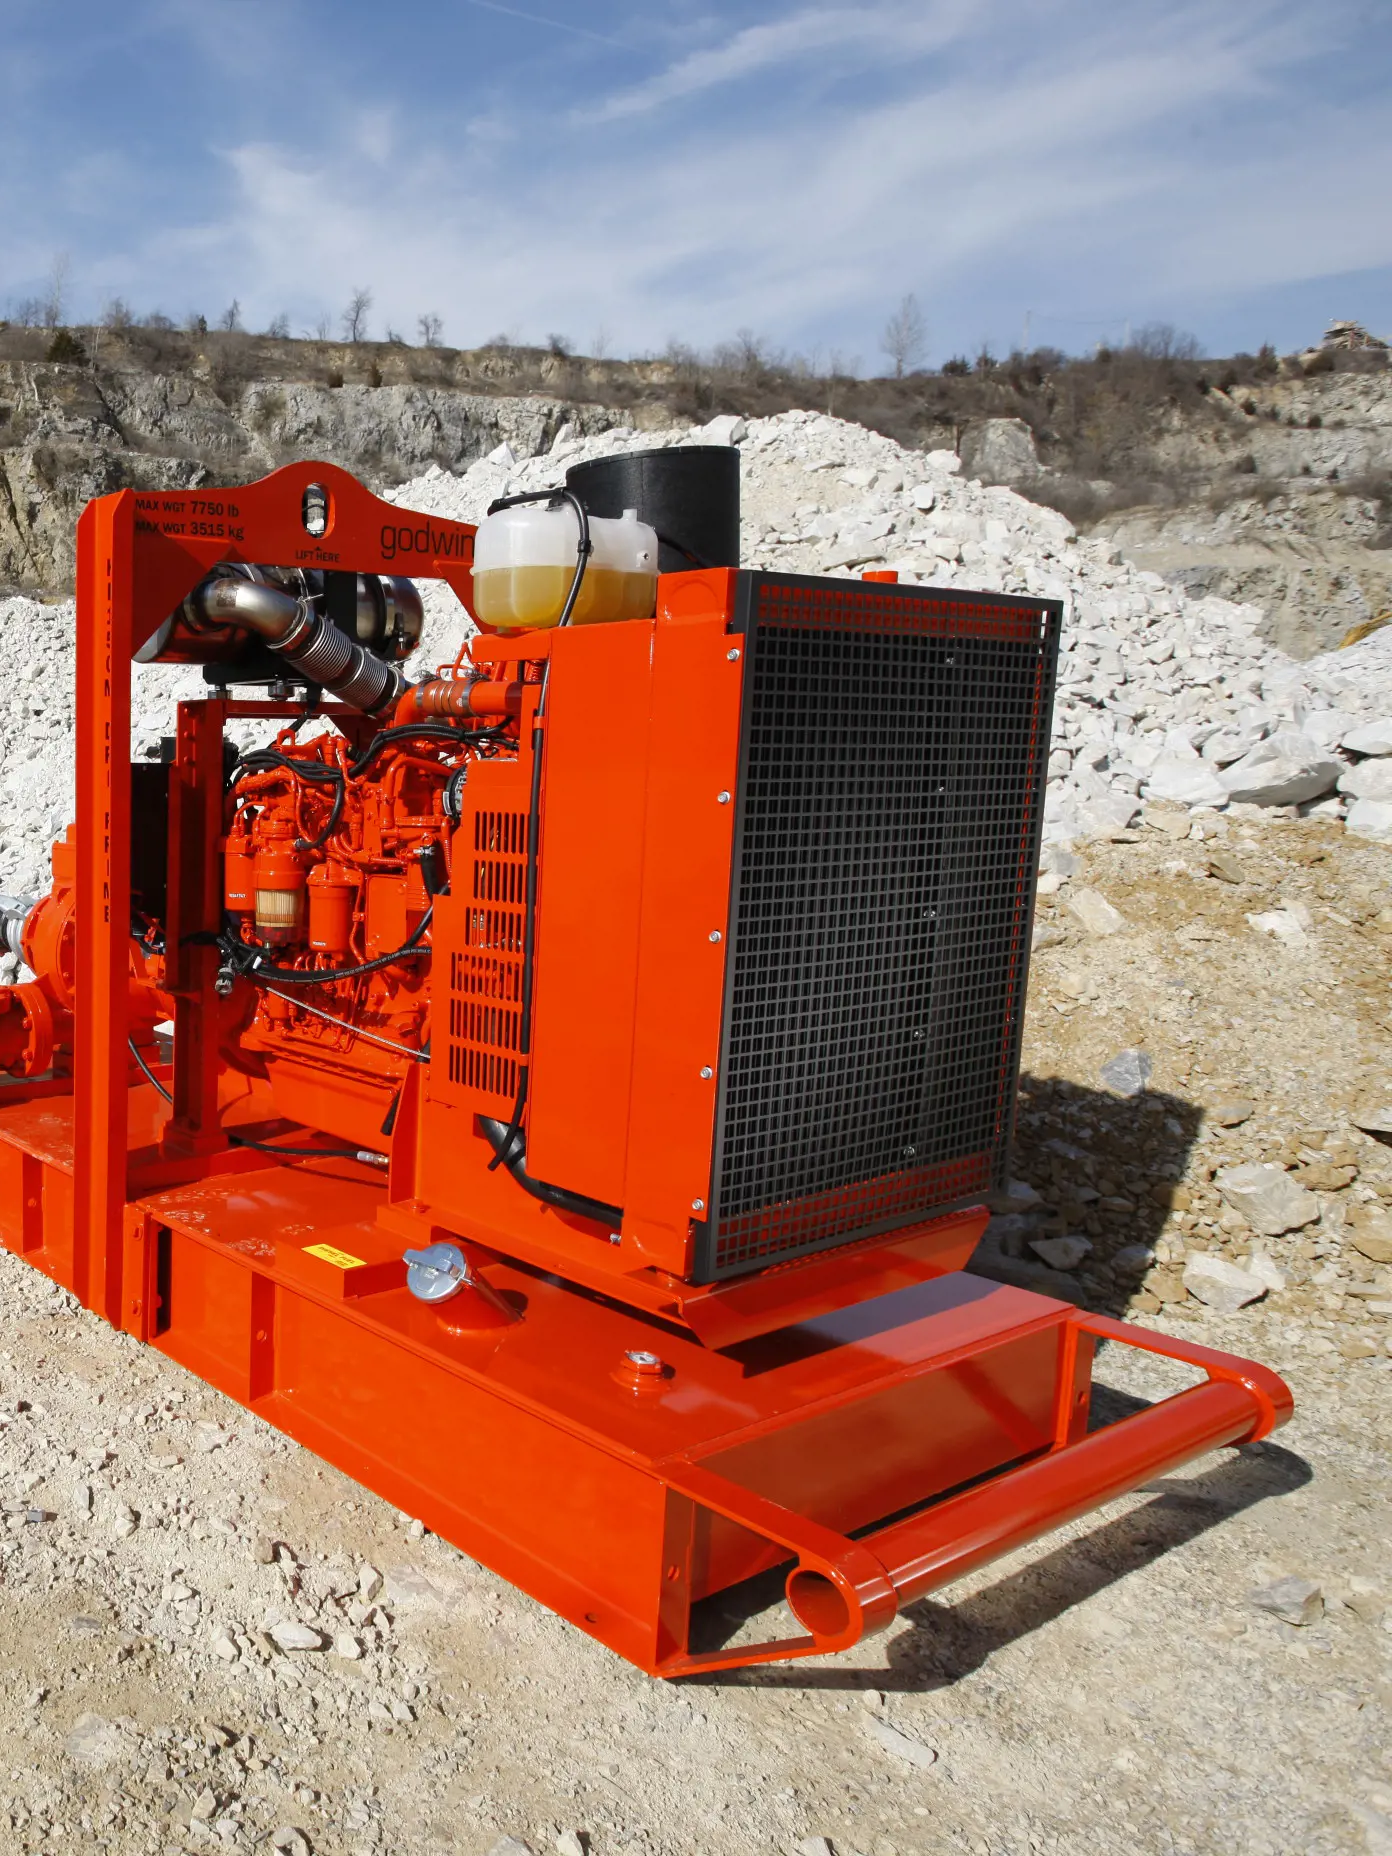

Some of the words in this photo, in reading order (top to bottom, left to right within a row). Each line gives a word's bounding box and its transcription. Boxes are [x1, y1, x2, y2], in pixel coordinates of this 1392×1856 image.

[135, 499, 159, 511] MAX
[163, 502, 186, 512] WGT
[190, 501, 224, 516] 7750
[228, 504, 239, 517] lb
[135, 521, 159, 533] MAX
[163, 523, 186, 534] WGT
[190, 522, 224, 537] 3515
[228, 525, 244, 540] kg
[380, 520, 475, 560] godwin
[296, 550, 314, 561] LIFT
[316, 551, 340, 562] HERE
